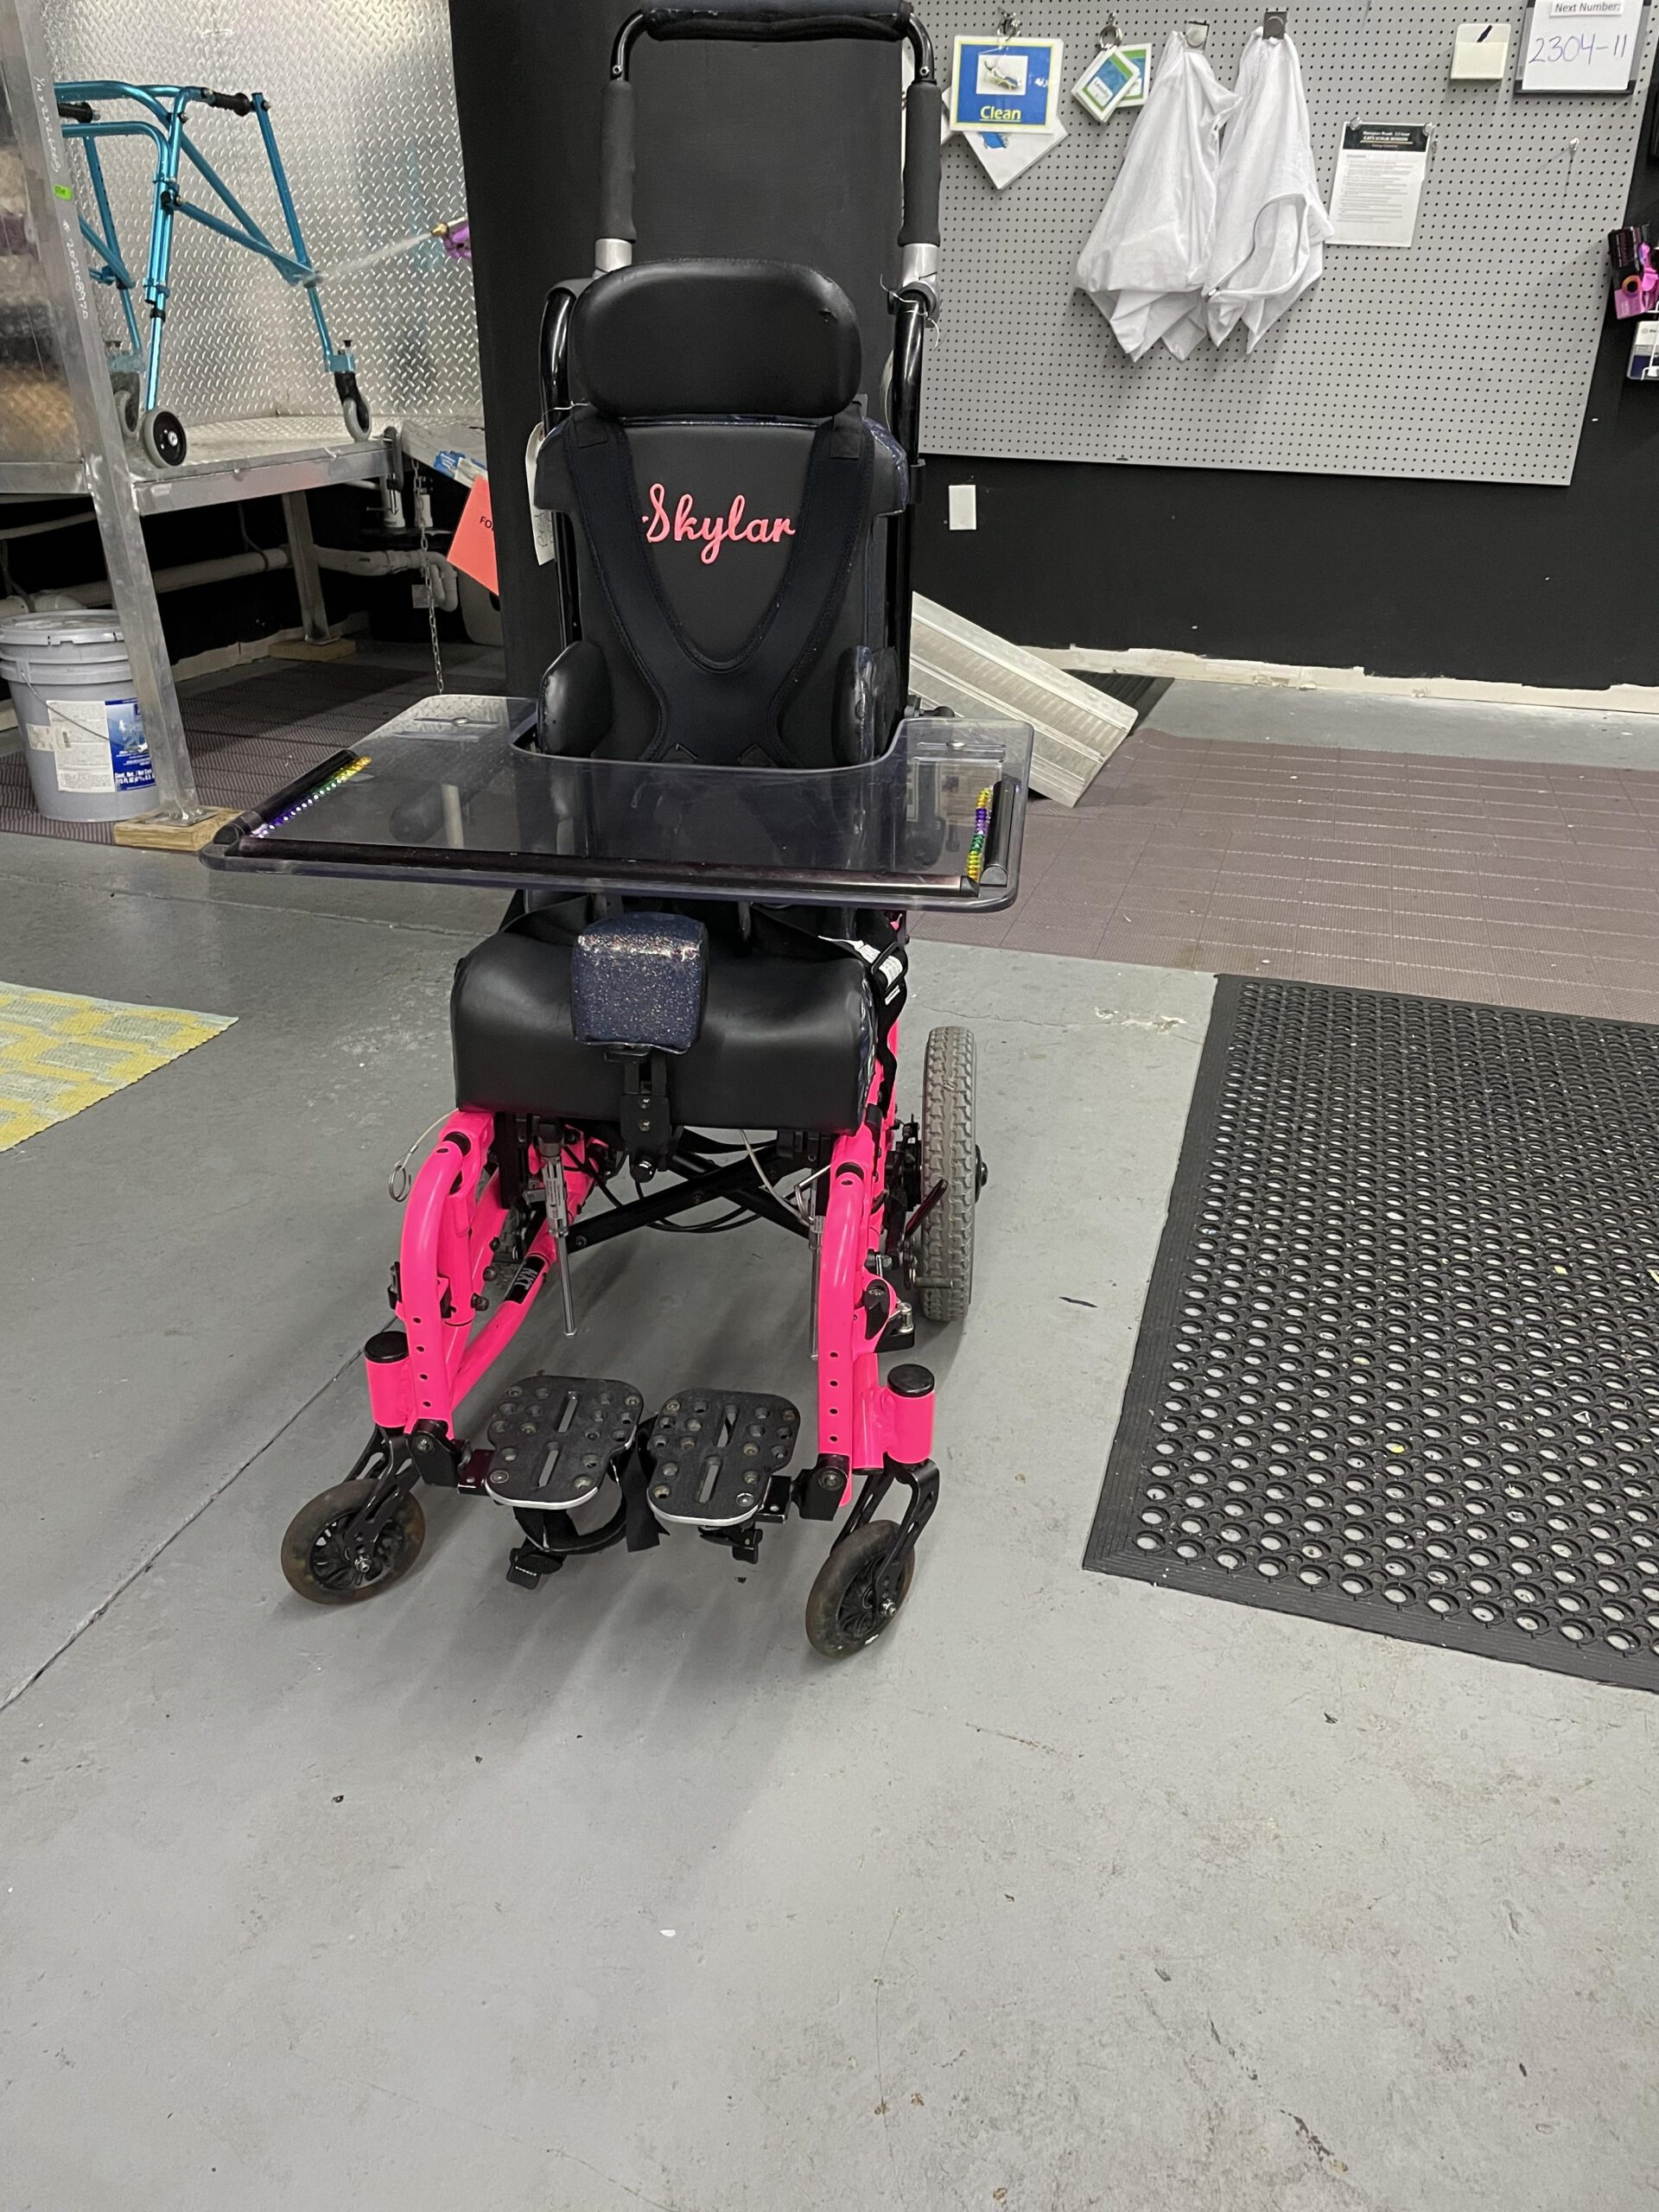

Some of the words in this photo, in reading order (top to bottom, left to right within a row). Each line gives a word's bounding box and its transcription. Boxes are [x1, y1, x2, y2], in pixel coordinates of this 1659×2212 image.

[1555, 3, 1576, 12] Next
[1579, 2, 1621, 12] Number:
[1528, 33, 1628, 65] 2304-11
[980, 105, 1021, 120] Clean
[480, 516, 494, 531] FO
[642, 483, 796, 564] Skylar
